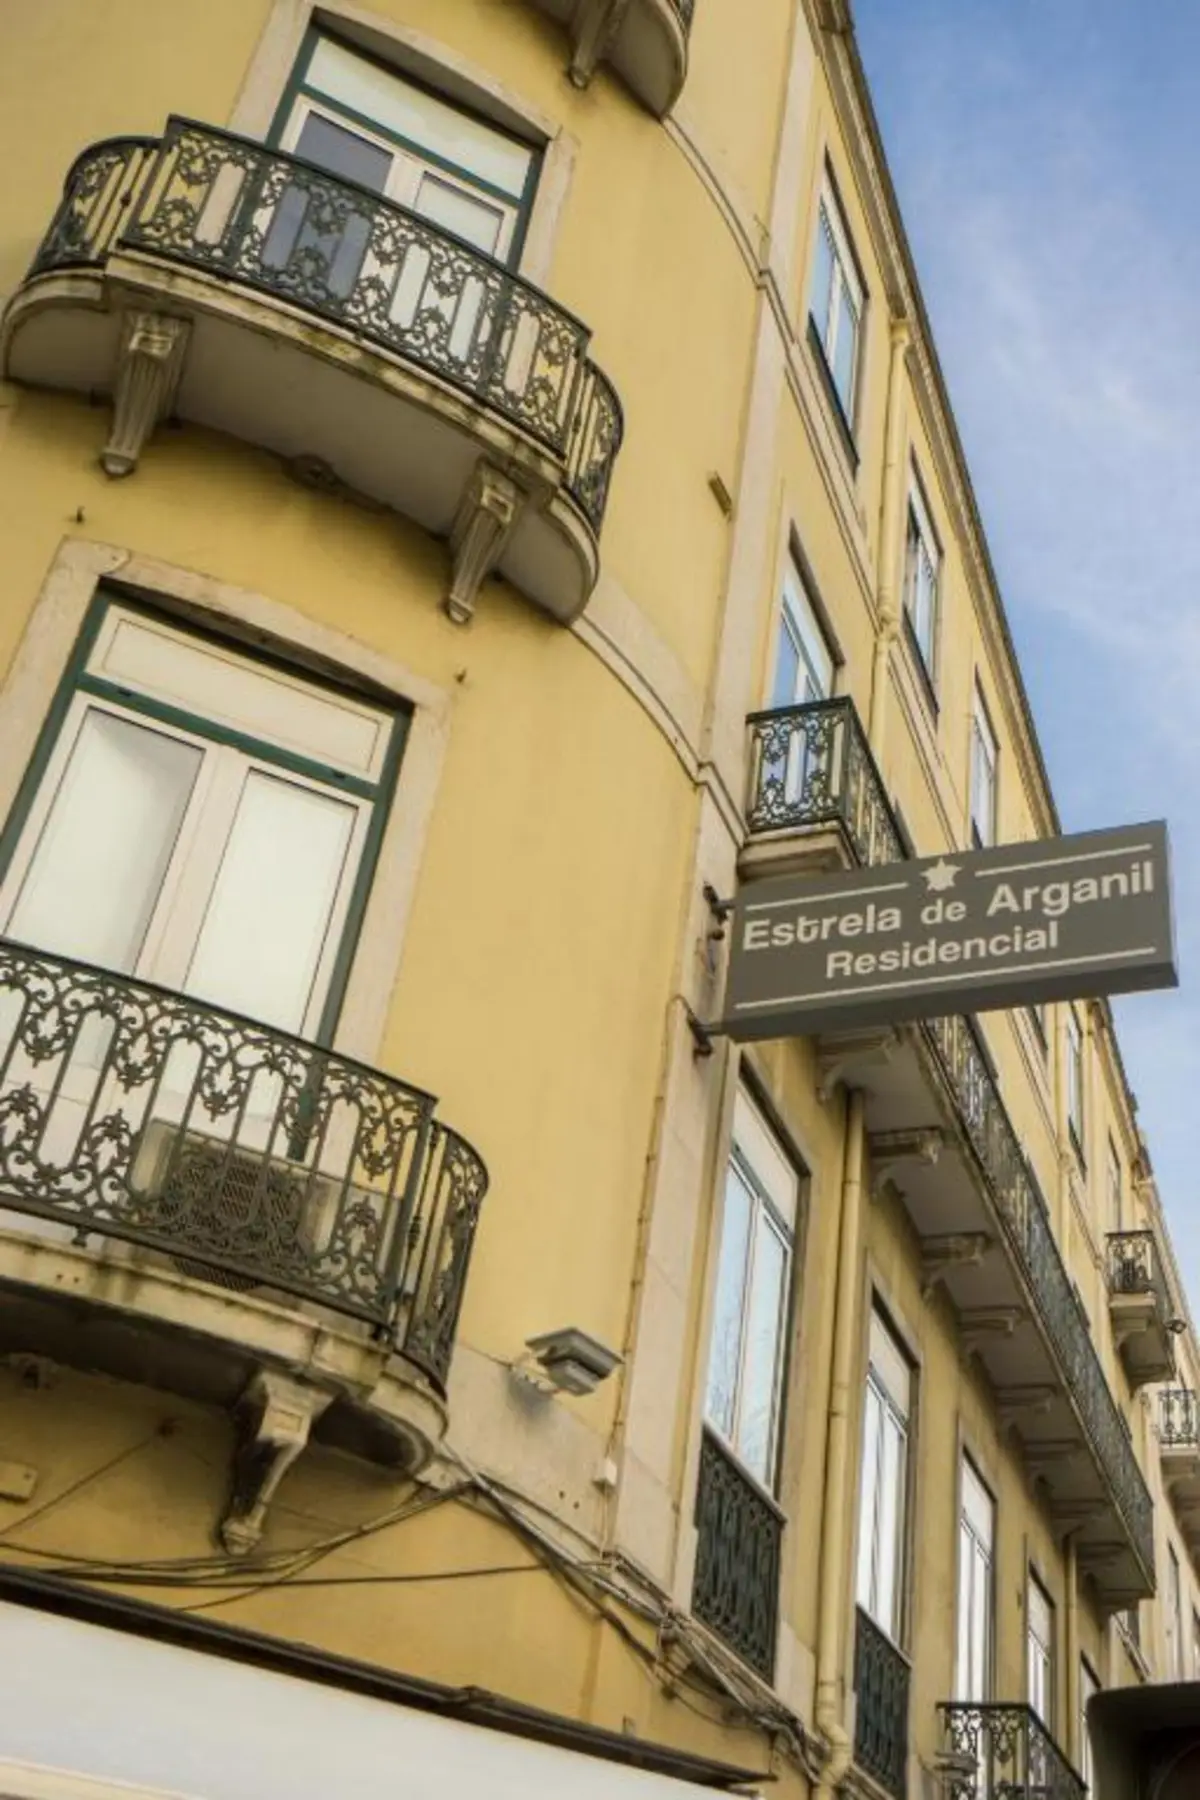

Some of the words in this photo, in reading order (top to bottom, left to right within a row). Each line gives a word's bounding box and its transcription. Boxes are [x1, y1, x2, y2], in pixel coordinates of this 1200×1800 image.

[742, 904, 901, 951] Estrela
[920, 899, 967, 925] de
[986, 861, 1155, 916] Arganil
[826, 922, 1058, 978] Residencial
